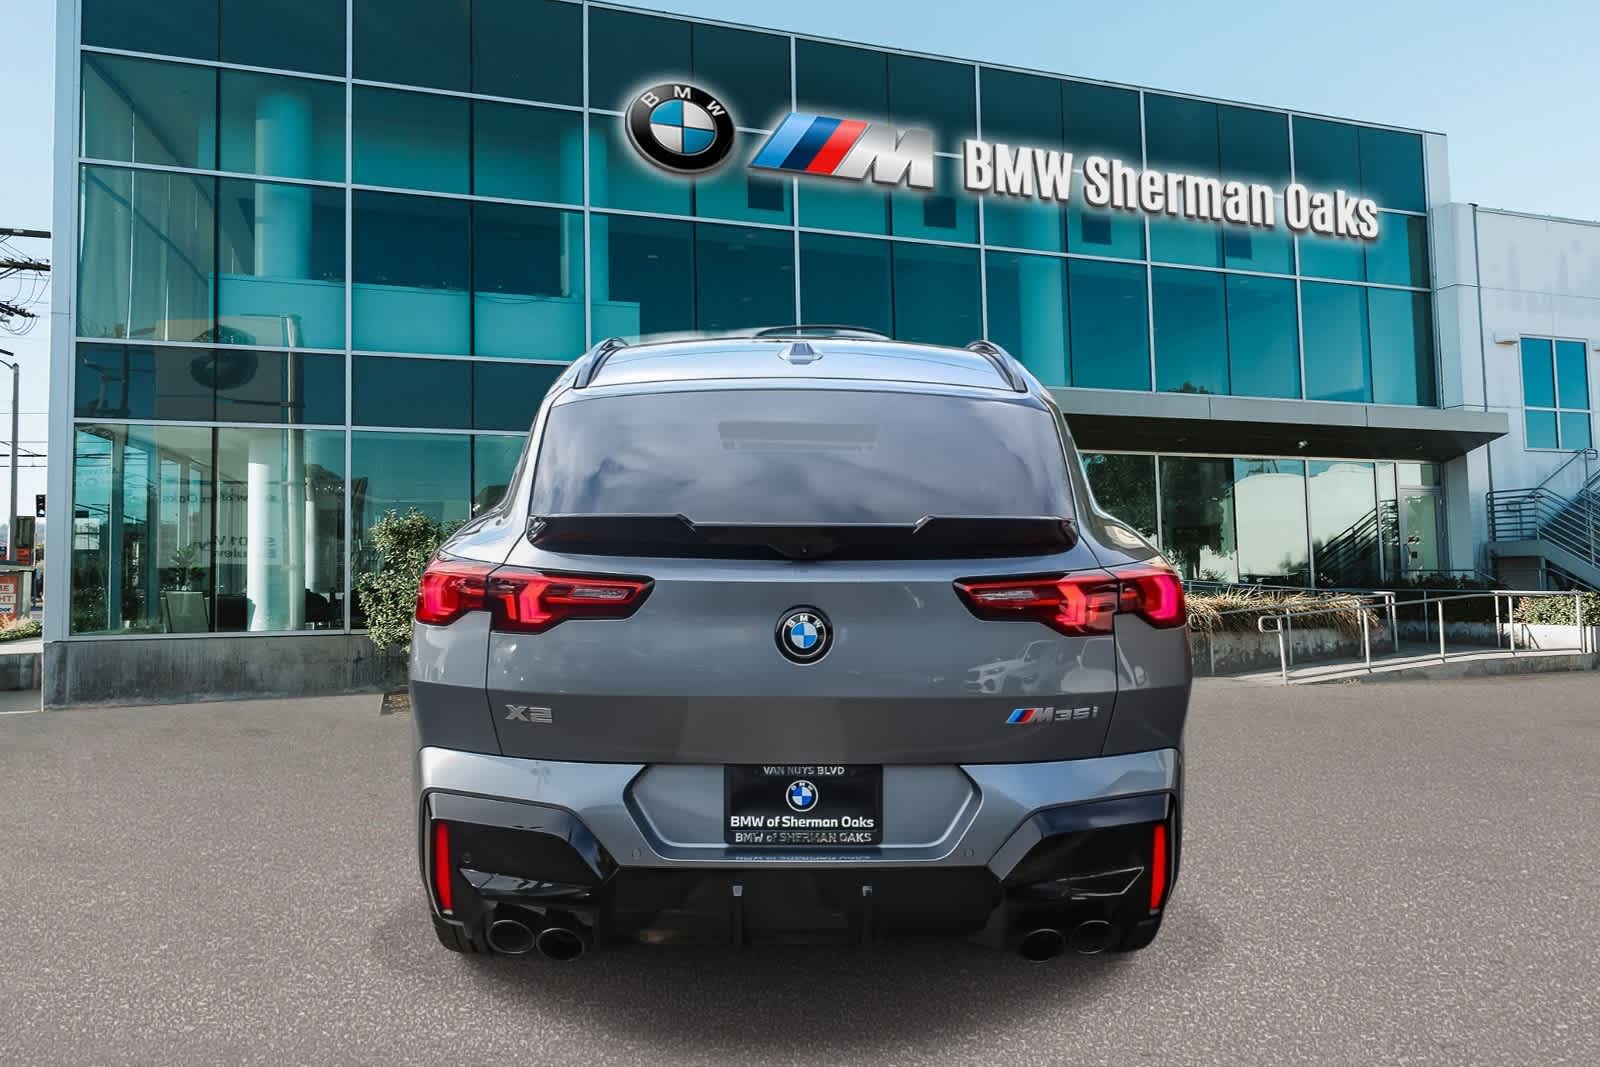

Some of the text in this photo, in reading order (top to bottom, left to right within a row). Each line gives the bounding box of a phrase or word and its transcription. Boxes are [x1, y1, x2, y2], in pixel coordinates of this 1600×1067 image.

[641, 85, 725, 117] BMW
[964, 139, 1380, 241] BMW Sherman Oaks
[763, 766, 785, 775] VAN
[817, 766, 845, 775] BLVD
[730, 816, 874, 827] BMW of Sherman Oaks
[735, 833, 764, 842] BMW
[839, 833, 872, 842] OAKS
